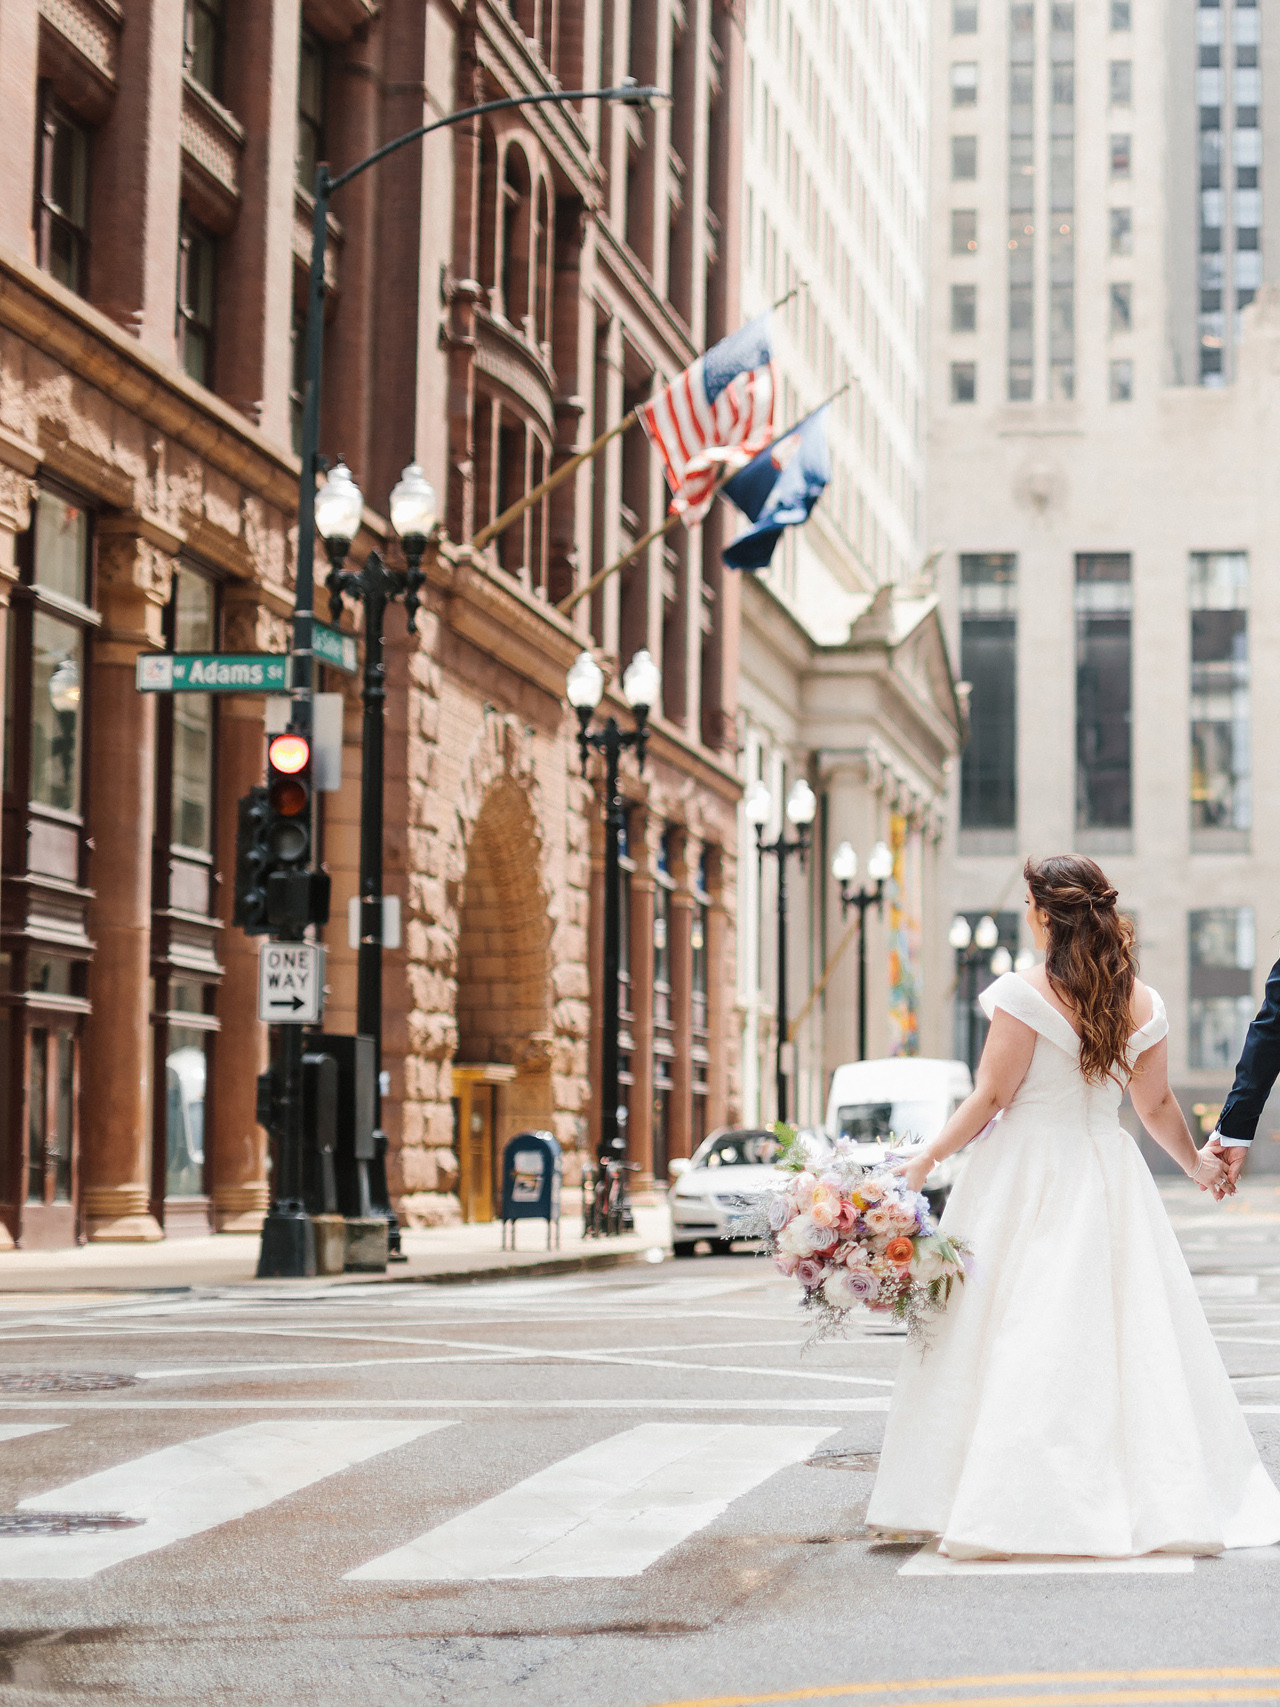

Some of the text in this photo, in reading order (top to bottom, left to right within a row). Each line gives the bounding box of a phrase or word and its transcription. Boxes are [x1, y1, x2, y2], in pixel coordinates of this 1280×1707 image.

[188, 660, 264, 684] Adams
[268, 951, 309, 970] ONE
[267, 971, 309, 990] WAY
